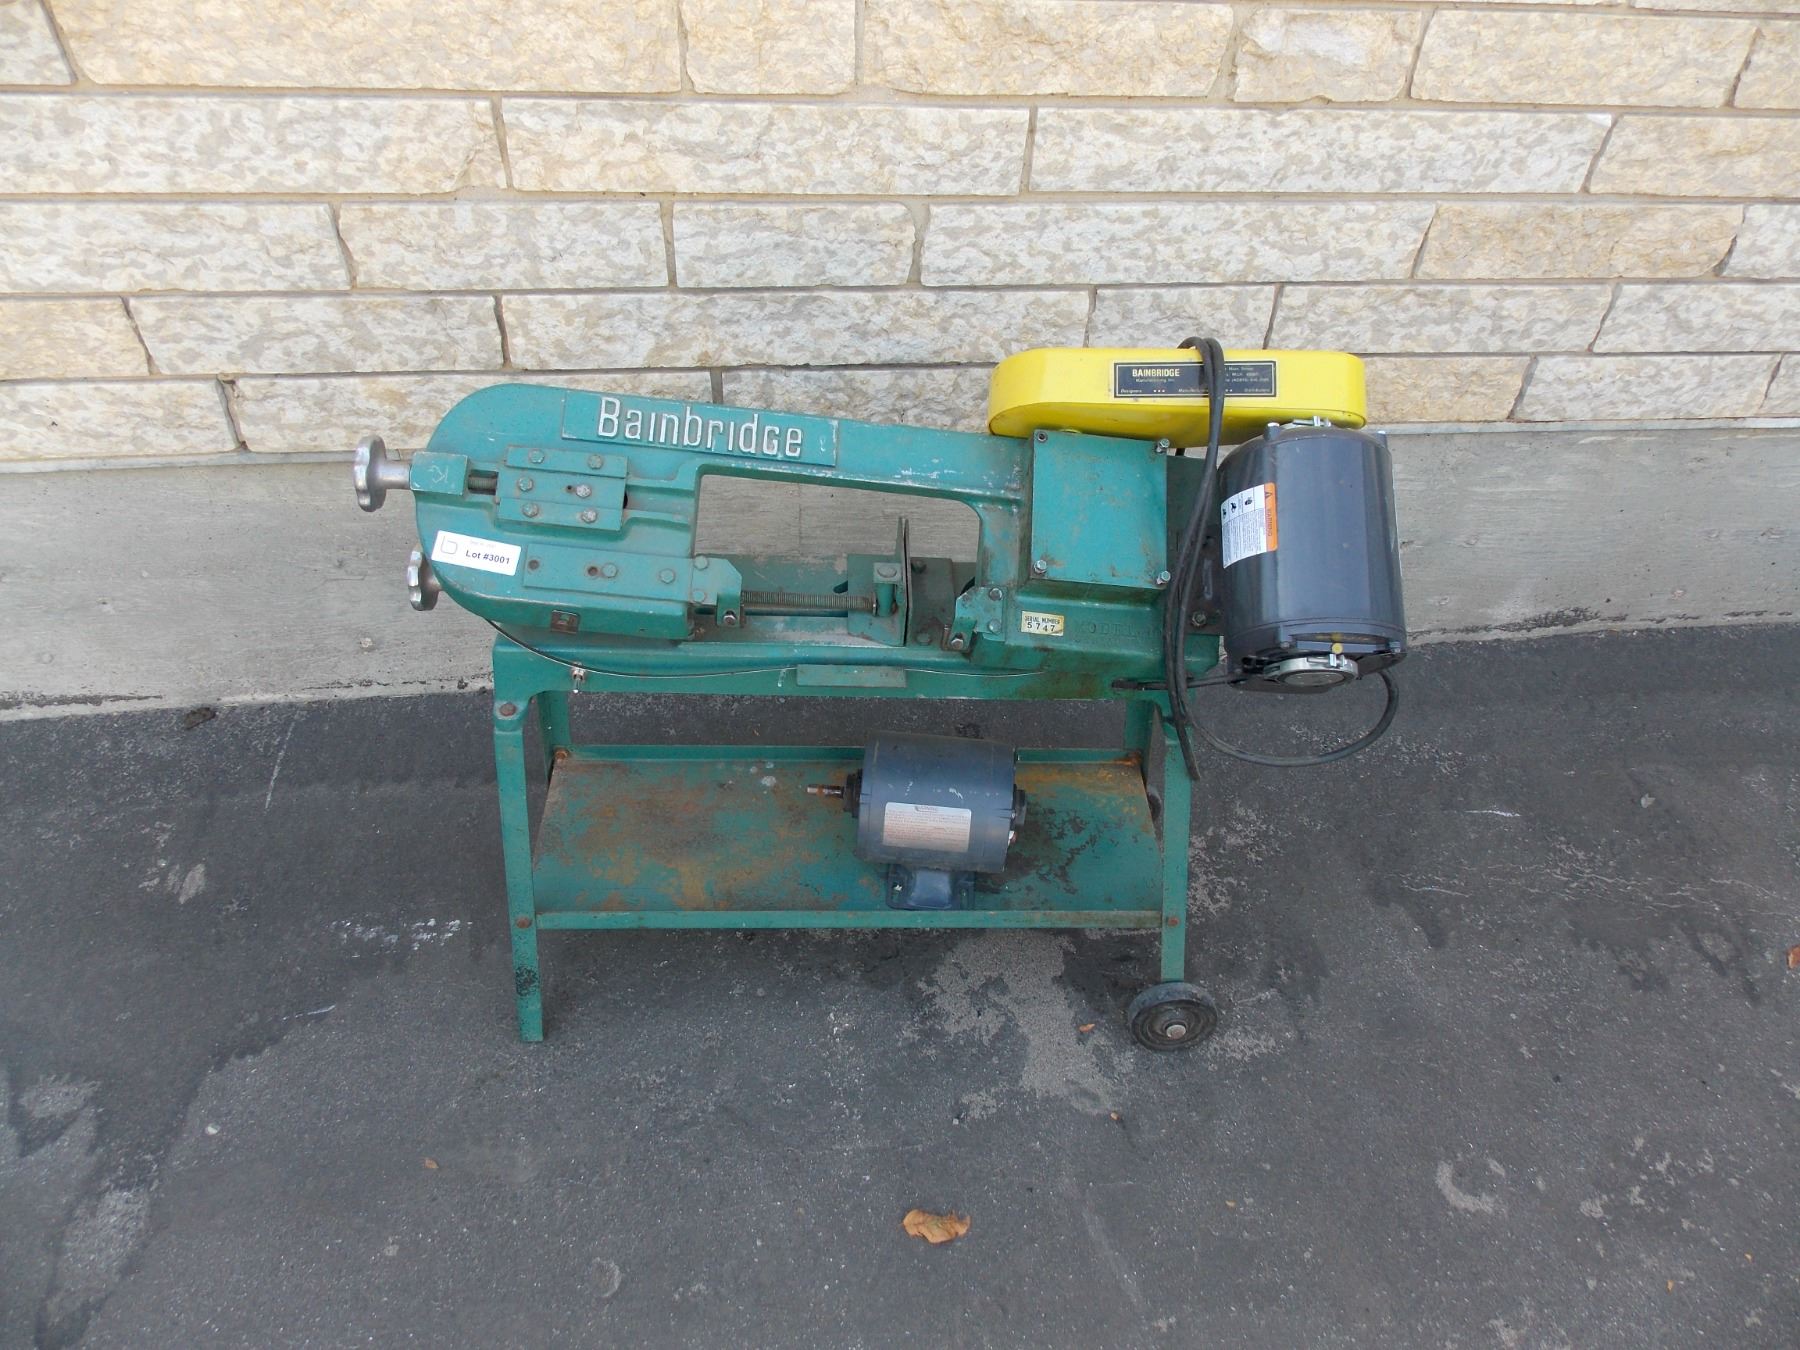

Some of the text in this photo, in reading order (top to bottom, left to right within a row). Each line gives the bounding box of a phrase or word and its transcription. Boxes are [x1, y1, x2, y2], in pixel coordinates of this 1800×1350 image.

[1132, 368, 1180, 377] BAINBRIDGE
[597, 396, 803, 457] Bainbridge
[465, 549, 511, 564] Lot #3001
[1024, 614, 1040, 622] SERIAL
